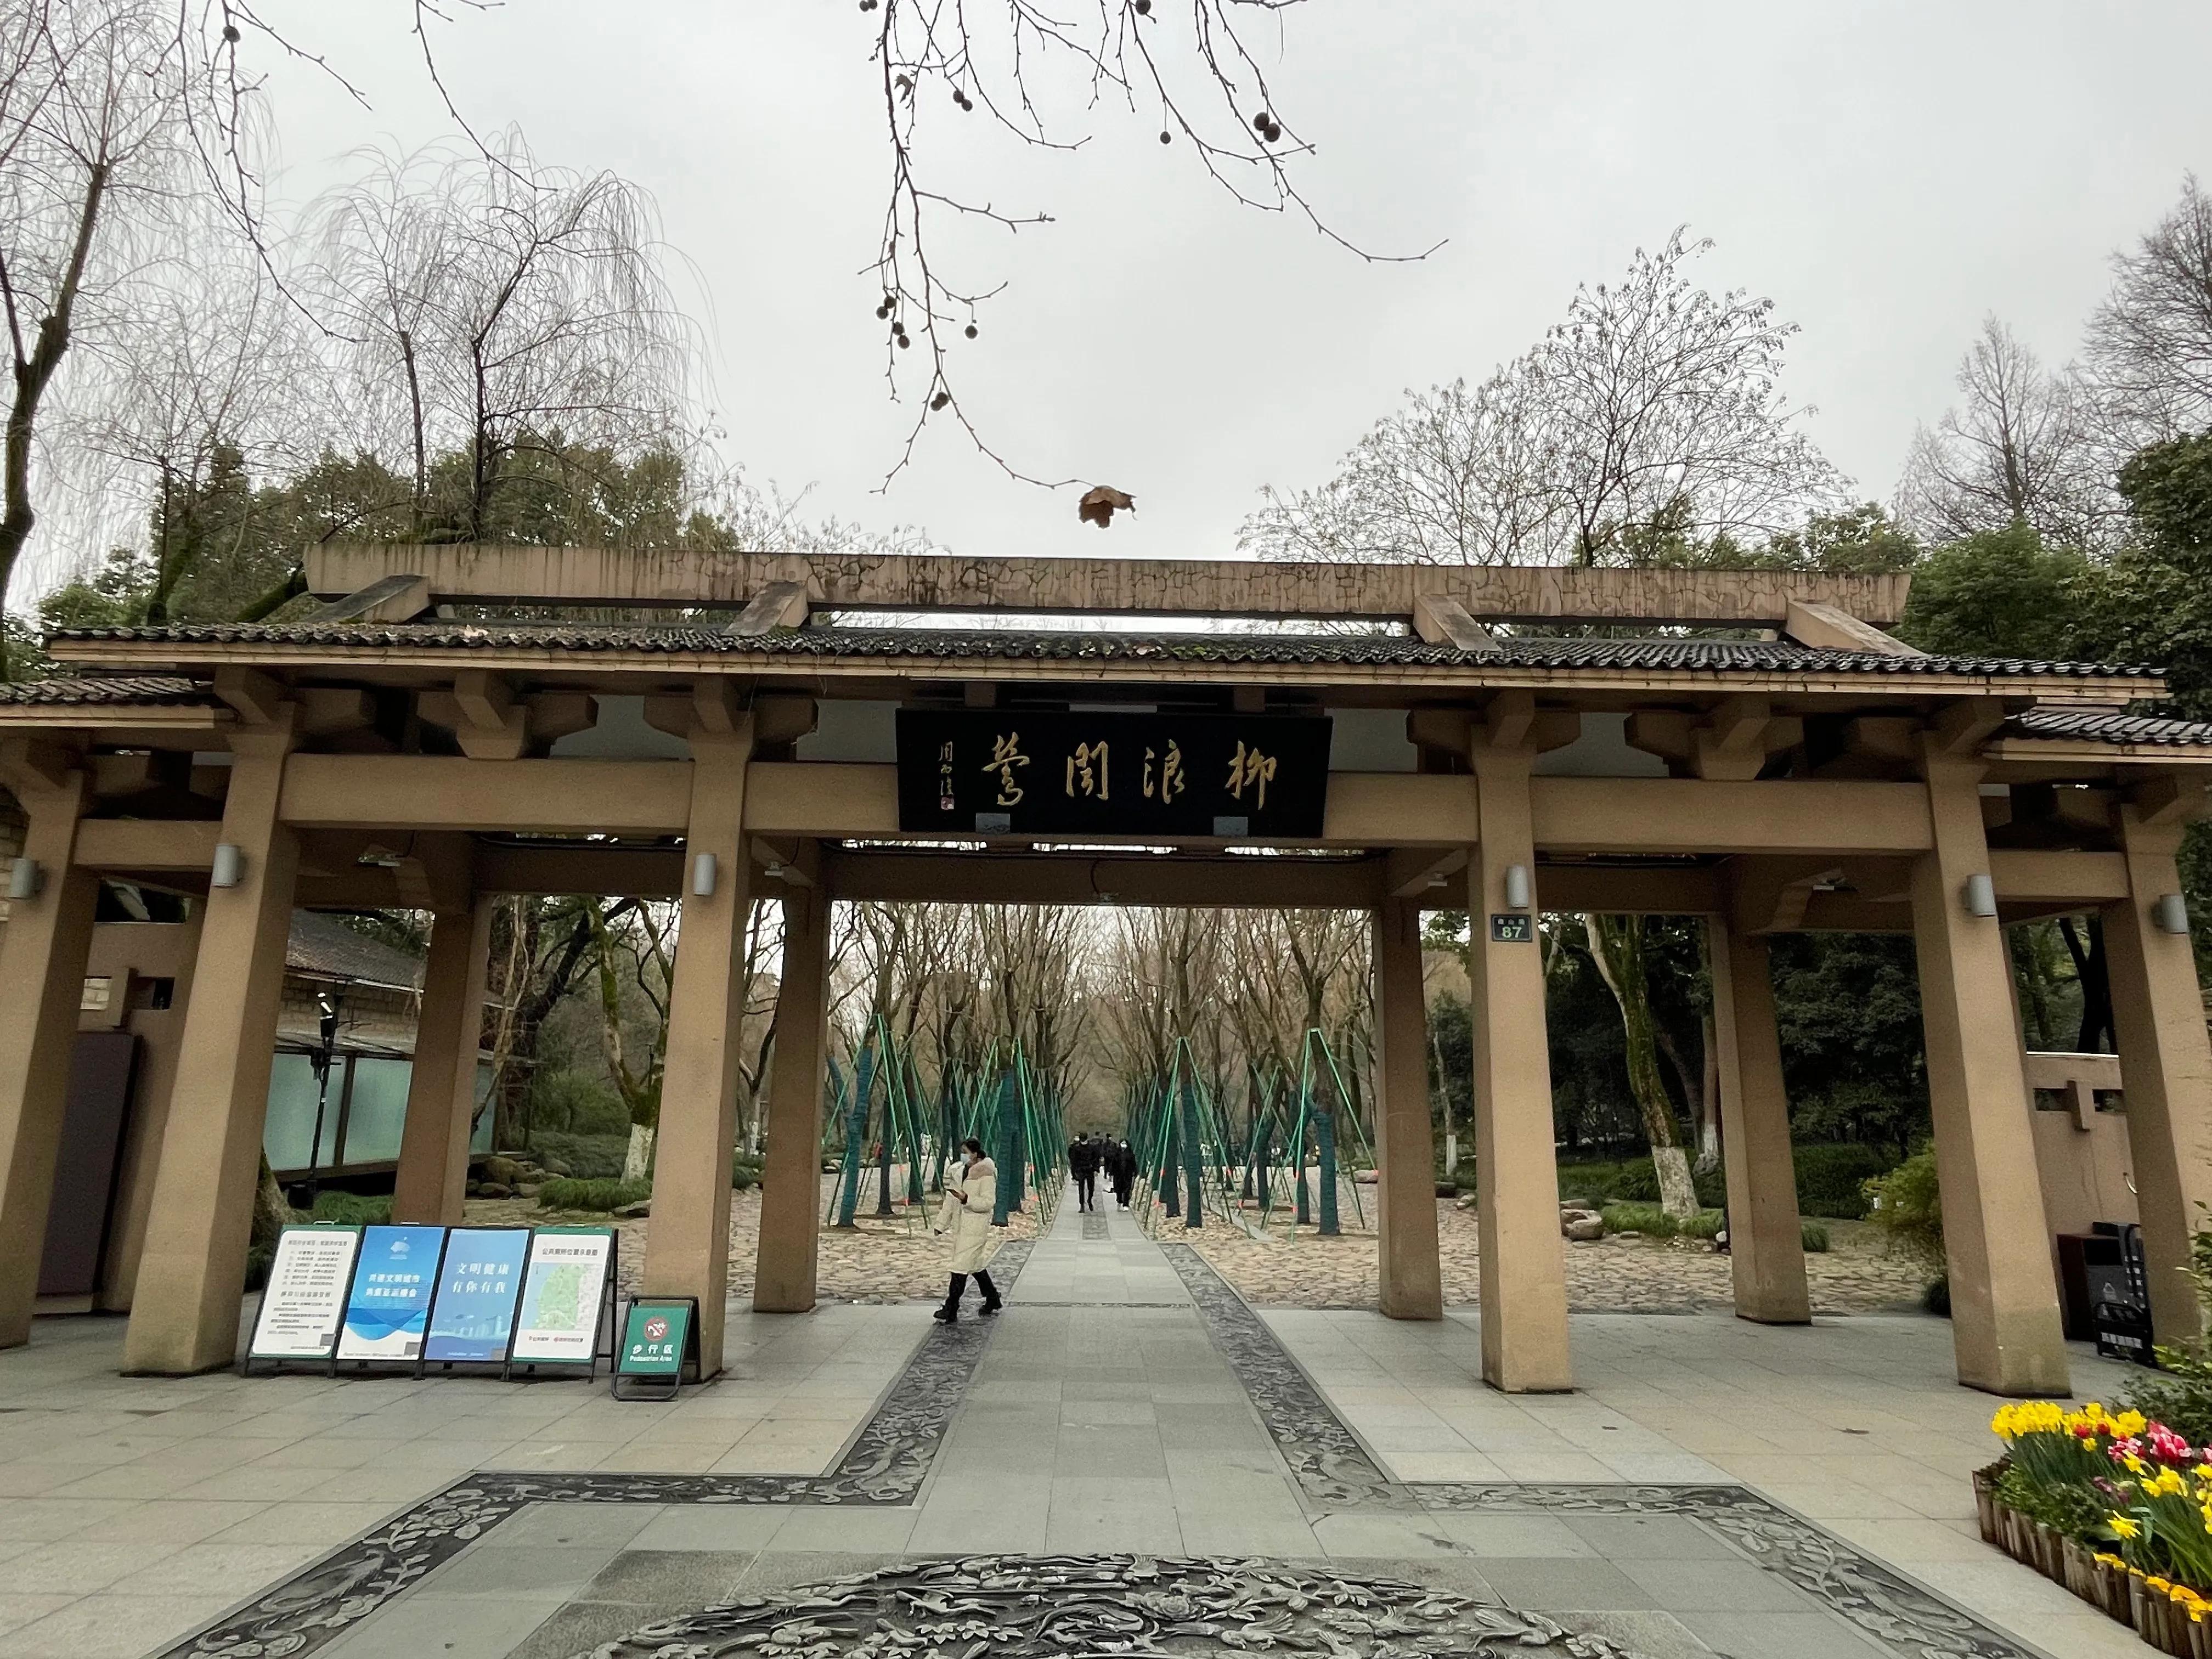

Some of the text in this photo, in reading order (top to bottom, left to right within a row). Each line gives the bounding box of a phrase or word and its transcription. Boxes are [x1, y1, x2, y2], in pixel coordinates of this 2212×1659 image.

[1502, 926, 1522, 938] 87
[632, 1344, 674, 1355] 步行区
